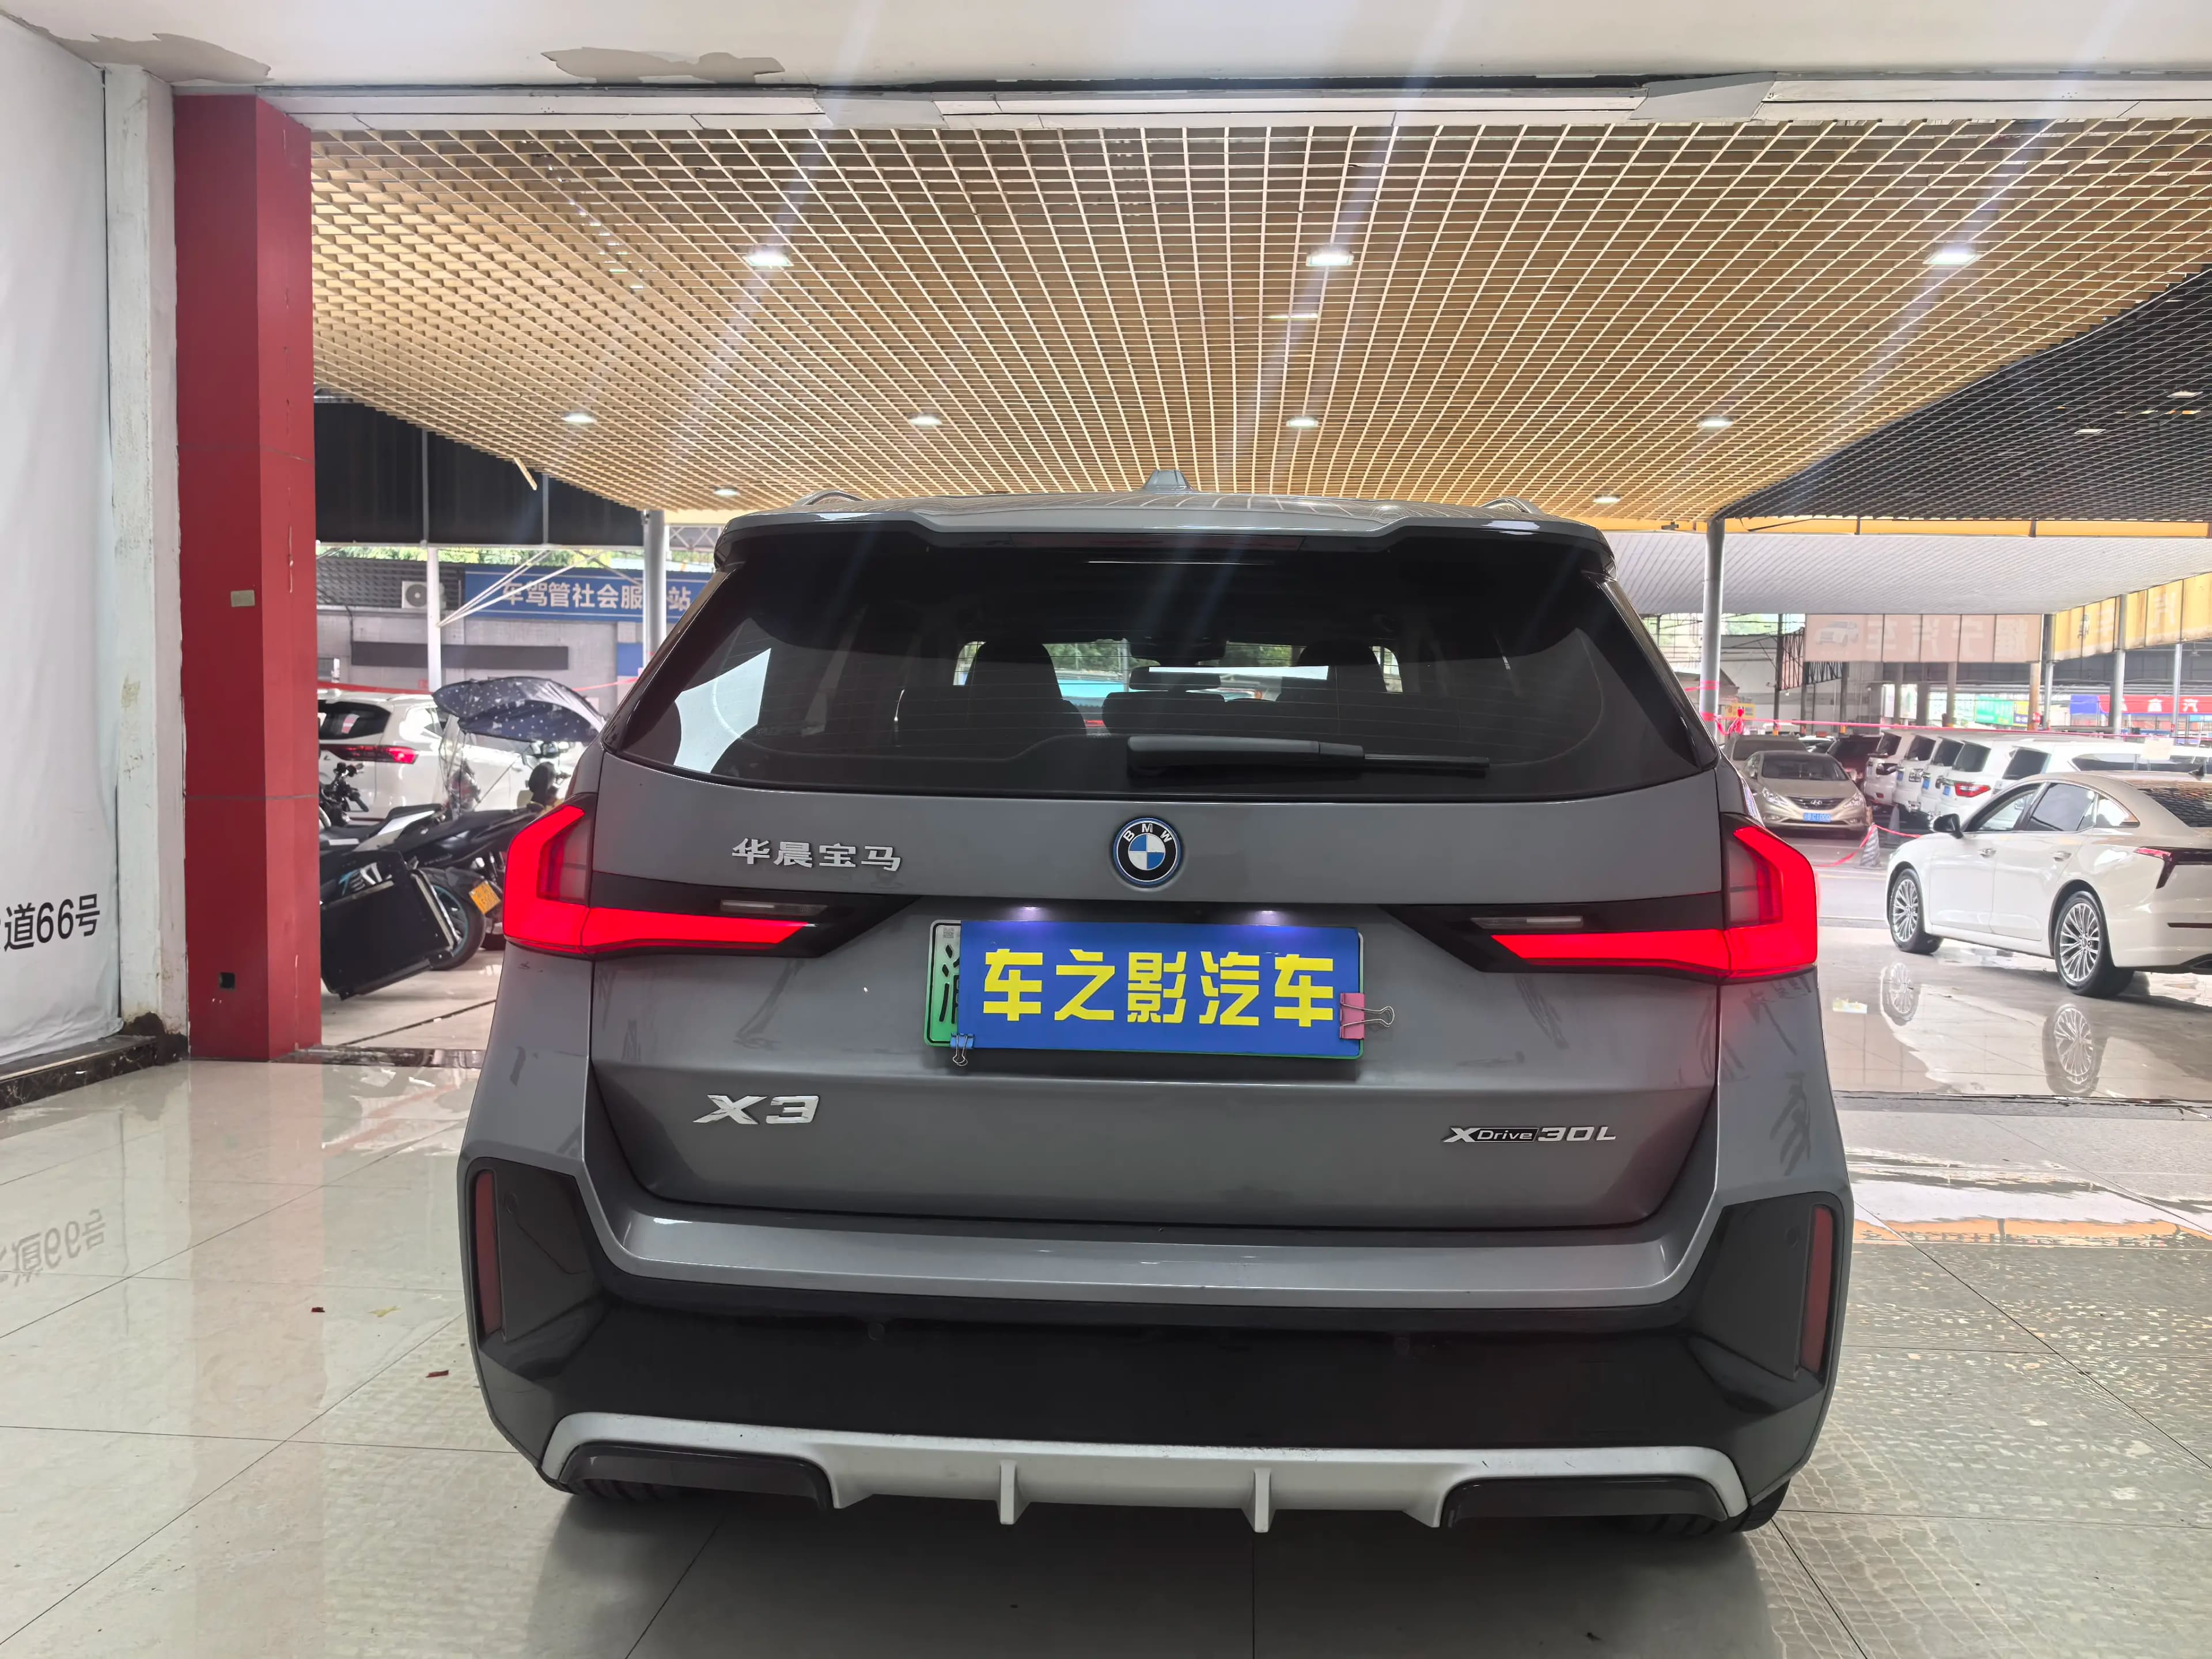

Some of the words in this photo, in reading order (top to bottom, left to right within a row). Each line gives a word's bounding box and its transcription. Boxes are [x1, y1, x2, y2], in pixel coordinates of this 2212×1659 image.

[502, 579, 692, 611] 车驾管社会服站
[1123, 823, 1172, 843] BMW
[732, 838, 901, 872] 华晨宝马
[4, 893, 100, 952] 道66号
[983, 948, 1334, 1027] 车之影汽车
[692, 1094, 819, 1124] X3
